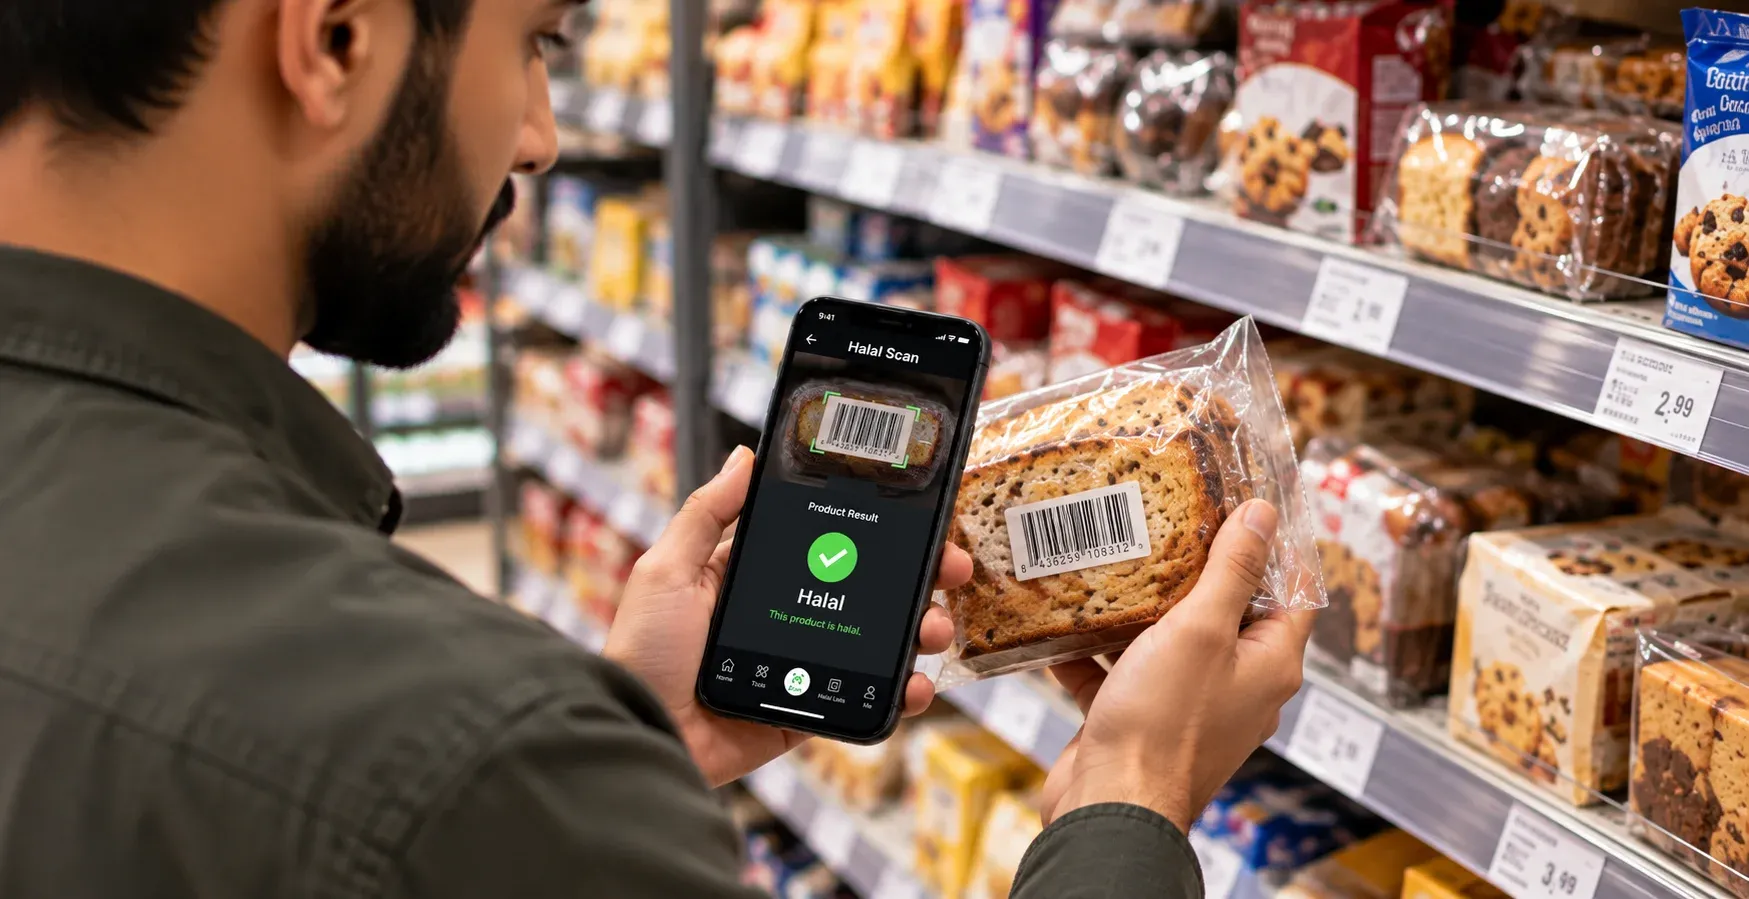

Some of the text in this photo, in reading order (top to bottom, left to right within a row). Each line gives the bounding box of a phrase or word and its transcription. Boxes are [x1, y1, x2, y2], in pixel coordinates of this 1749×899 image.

[818, 312, 835, 321] 9:41
[847, 340, 919, 364] Halal Scan
[1654, 391, 1694, 418] 2.99
[807, 501, 879, 523] Product Result
[1021, 564, 1027, 574] 8
[1039, 552, 1081, 569] 436259
[1087, 542, 1130, 560] 108312
[796, 588, 846, 611] Halal
[769, 609, 862, 636] This product is halal.
